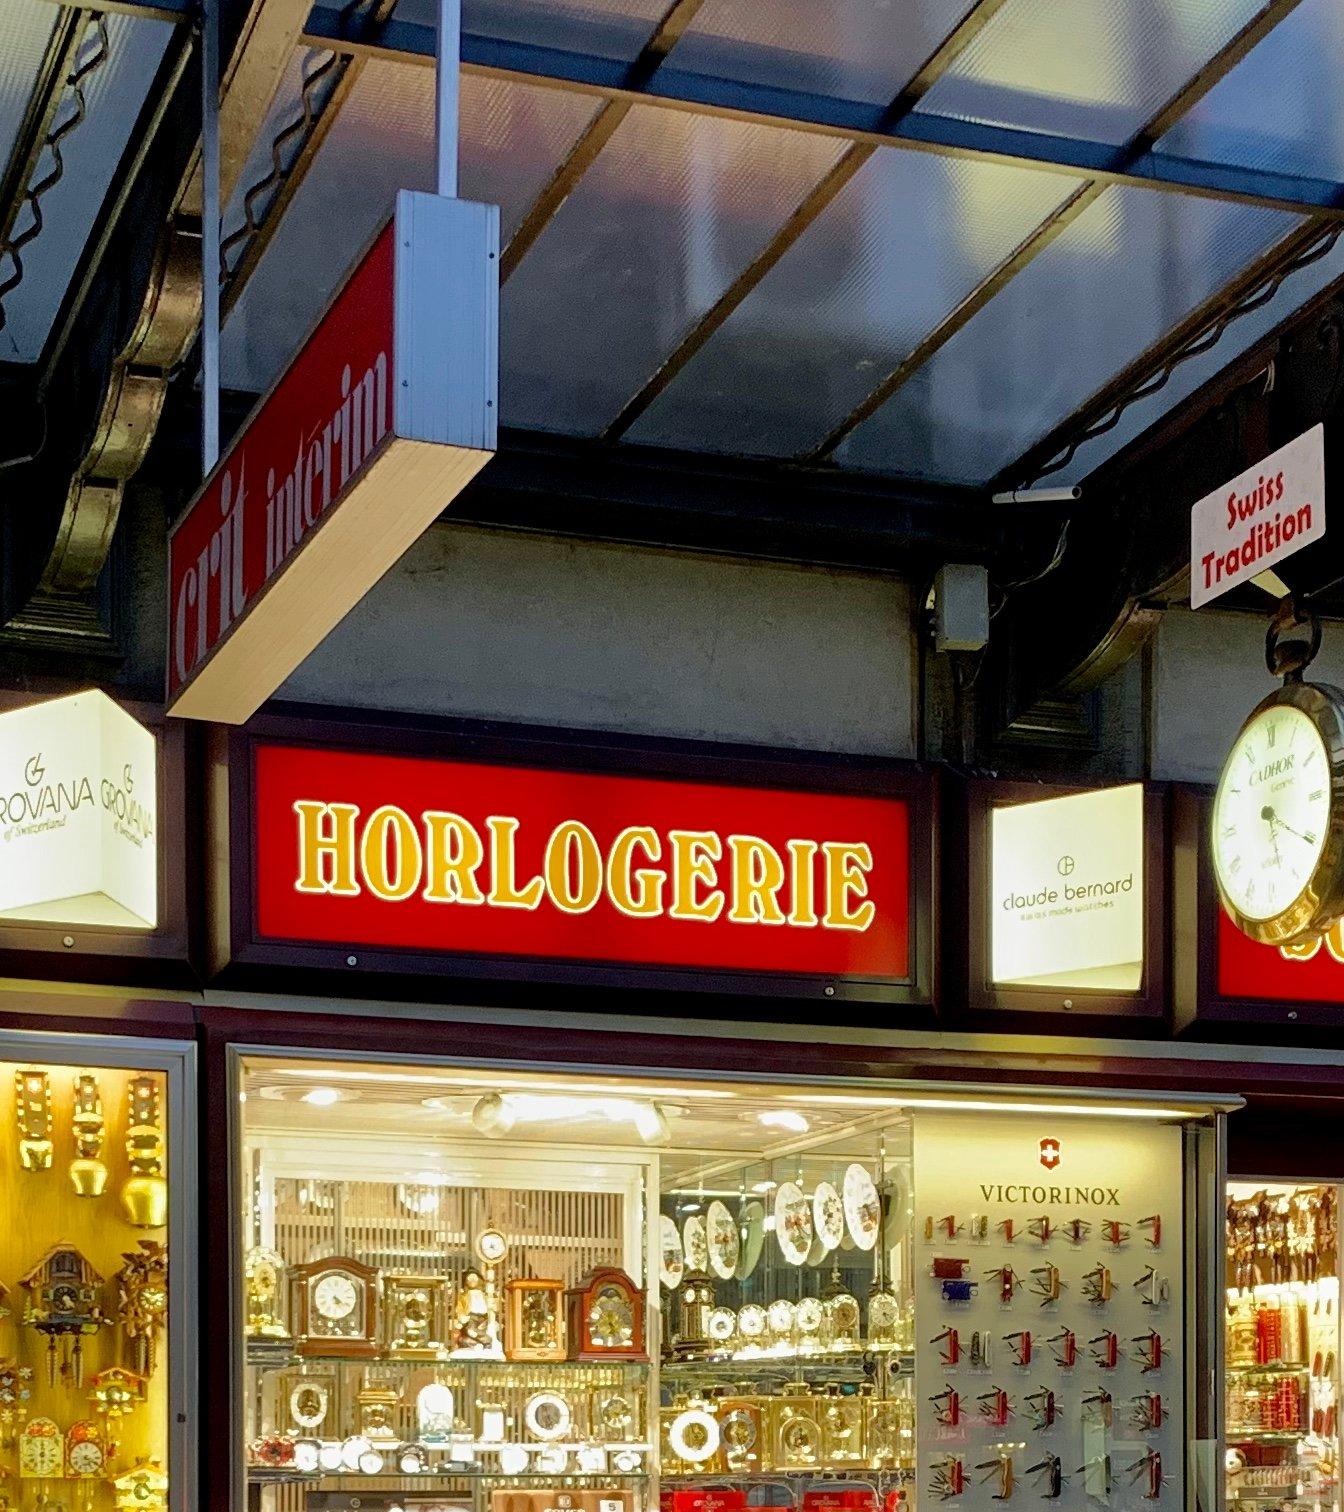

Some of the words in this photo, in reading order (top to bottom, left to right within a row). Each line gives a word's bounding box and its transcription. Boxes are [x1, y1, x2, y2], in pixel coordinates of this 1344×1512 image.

[175, 449, 249, 682] crit
[266, 351, 387, 579] intérim
[1227, 471, 1284, 530] Swiss
[1202, 504, 1312, 589] Tradition
[293, 799, 876, 931] HORLOGERIE
[1003, 886, 1058, 911] claude
[1064, 873, 1133, 901] bernard
[979, 1184, 1121, 1206] VICTORINOX
